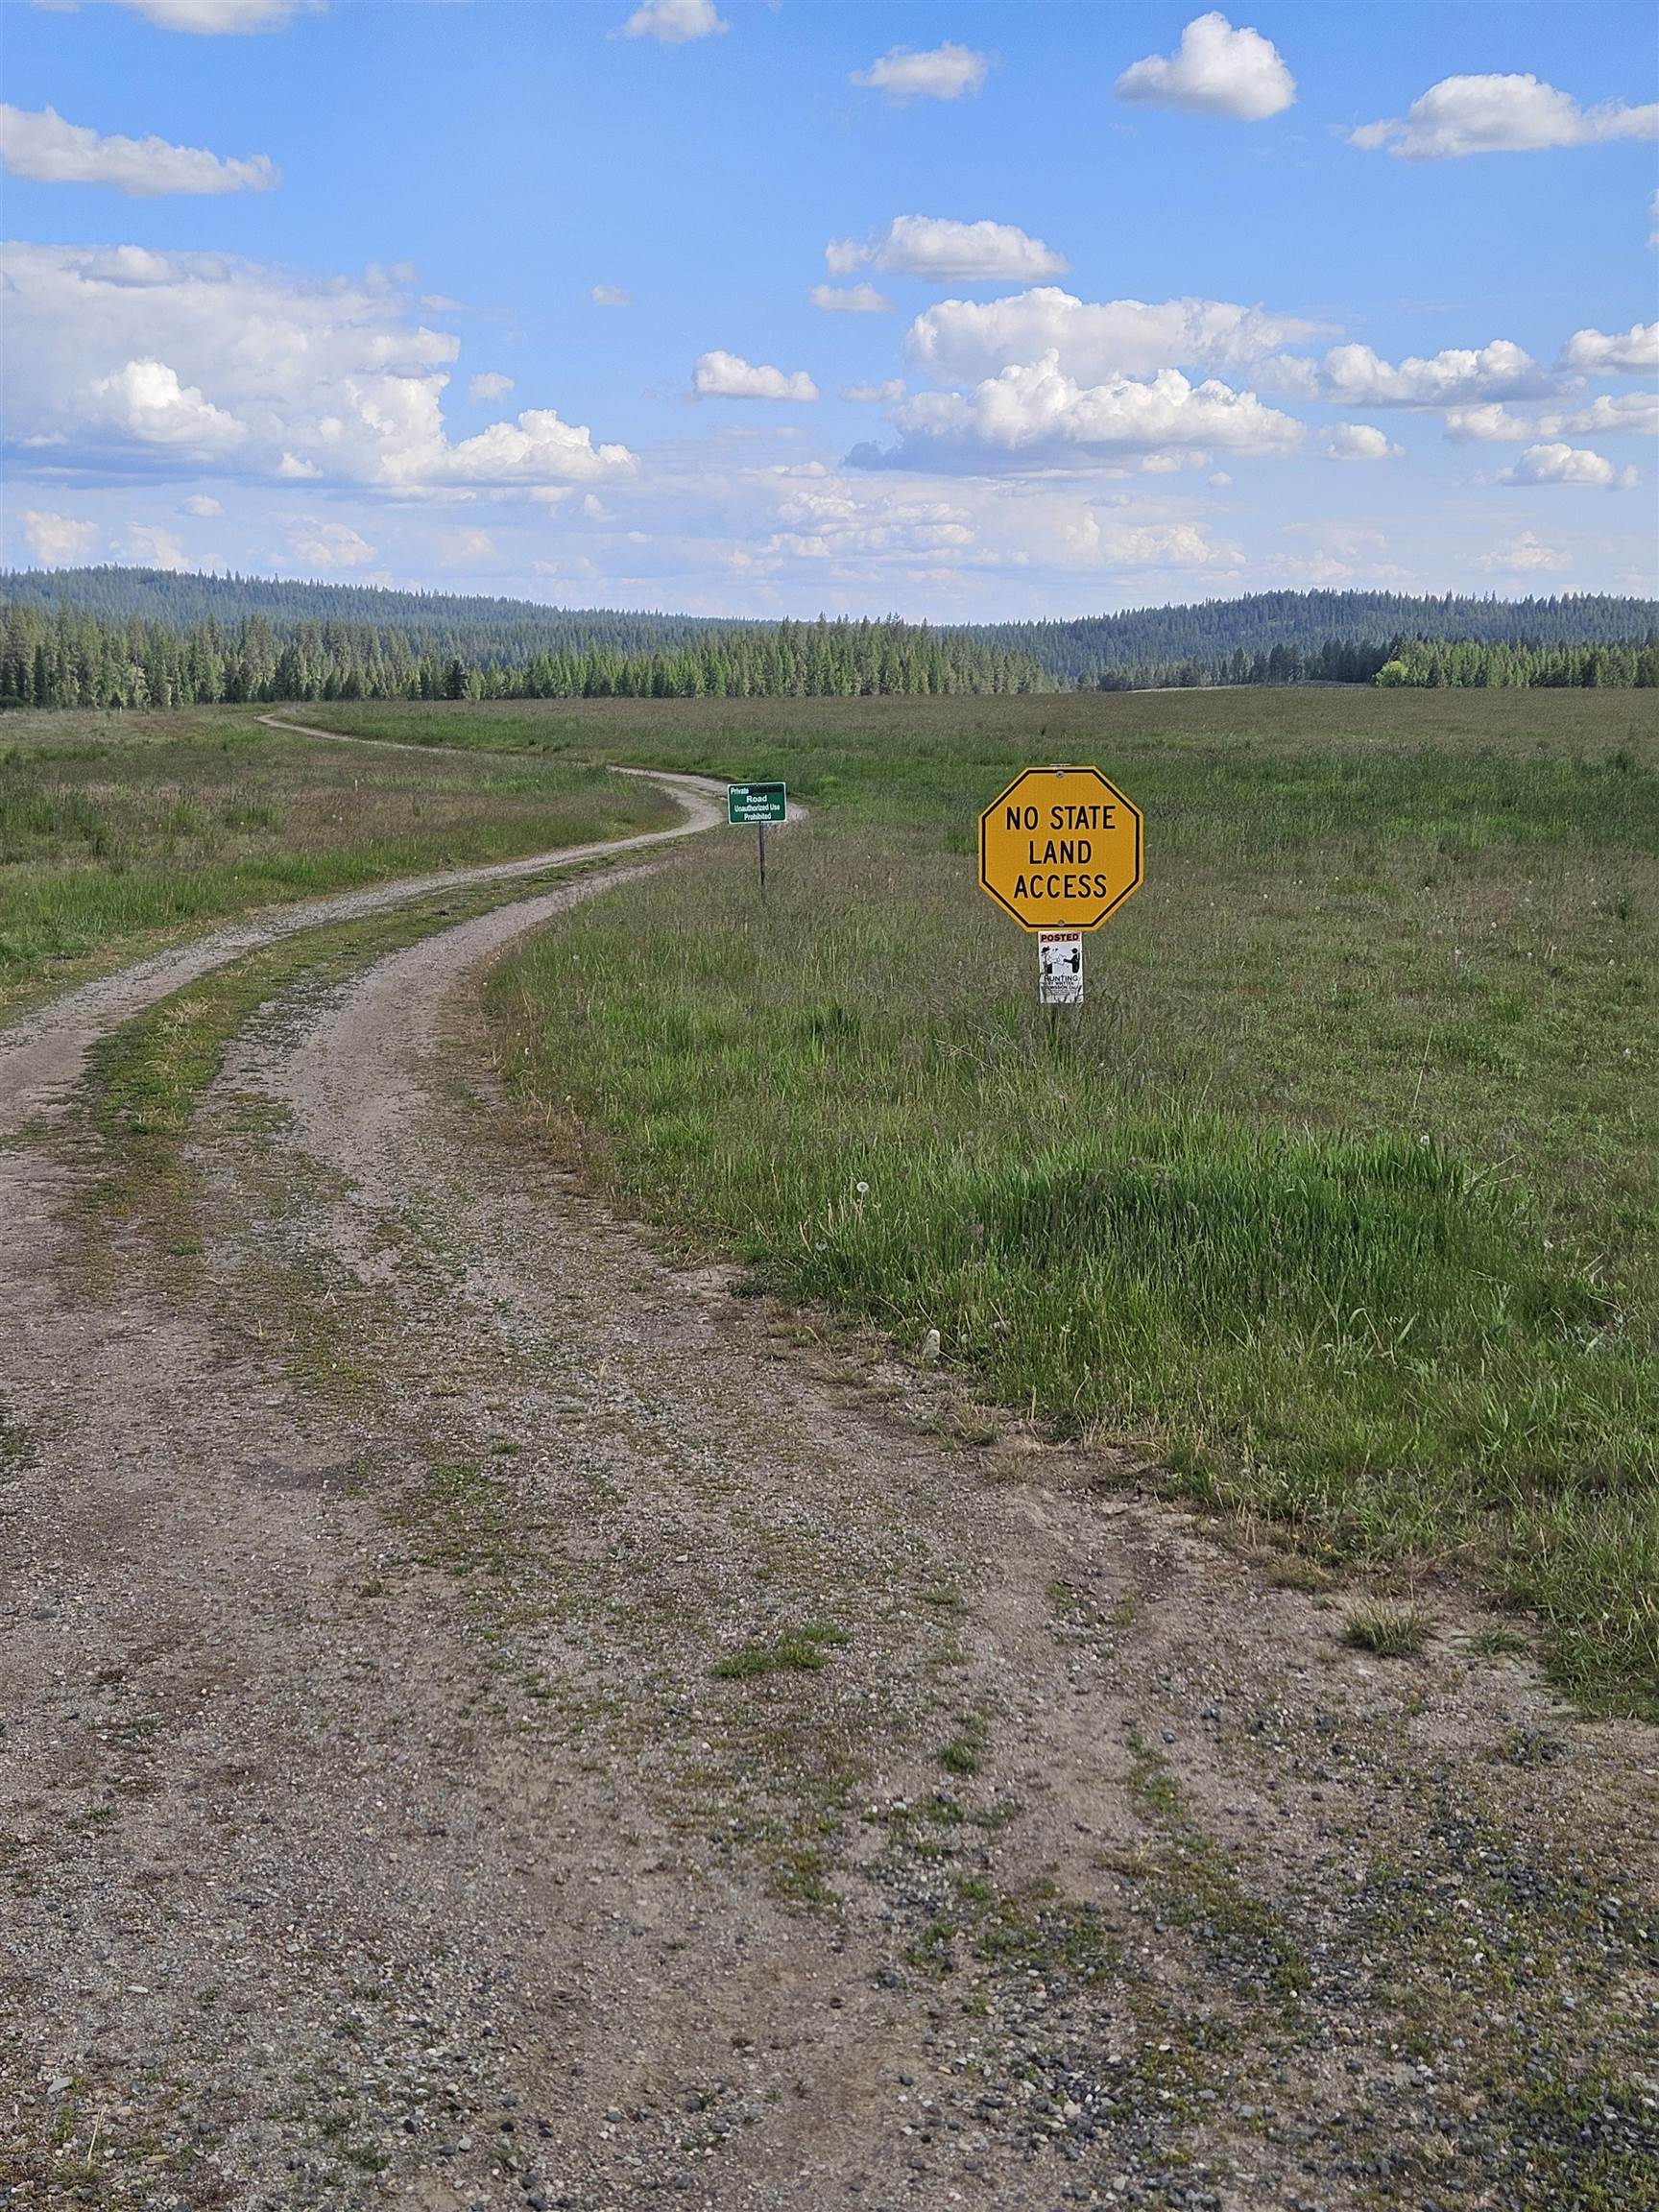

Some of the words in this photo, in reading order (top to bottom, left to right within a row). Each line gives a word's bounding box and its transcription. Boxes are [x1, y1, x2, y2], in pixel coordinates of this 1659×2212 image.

[734, 804, 769, 812] Unauthorized
[1006, 805, 1039, 830] NO
[1050, 805, 1116, 830] STATE
[1029, 840, 1092, 864] LAND
[1014, 875, 1107, 899] ACCESS
